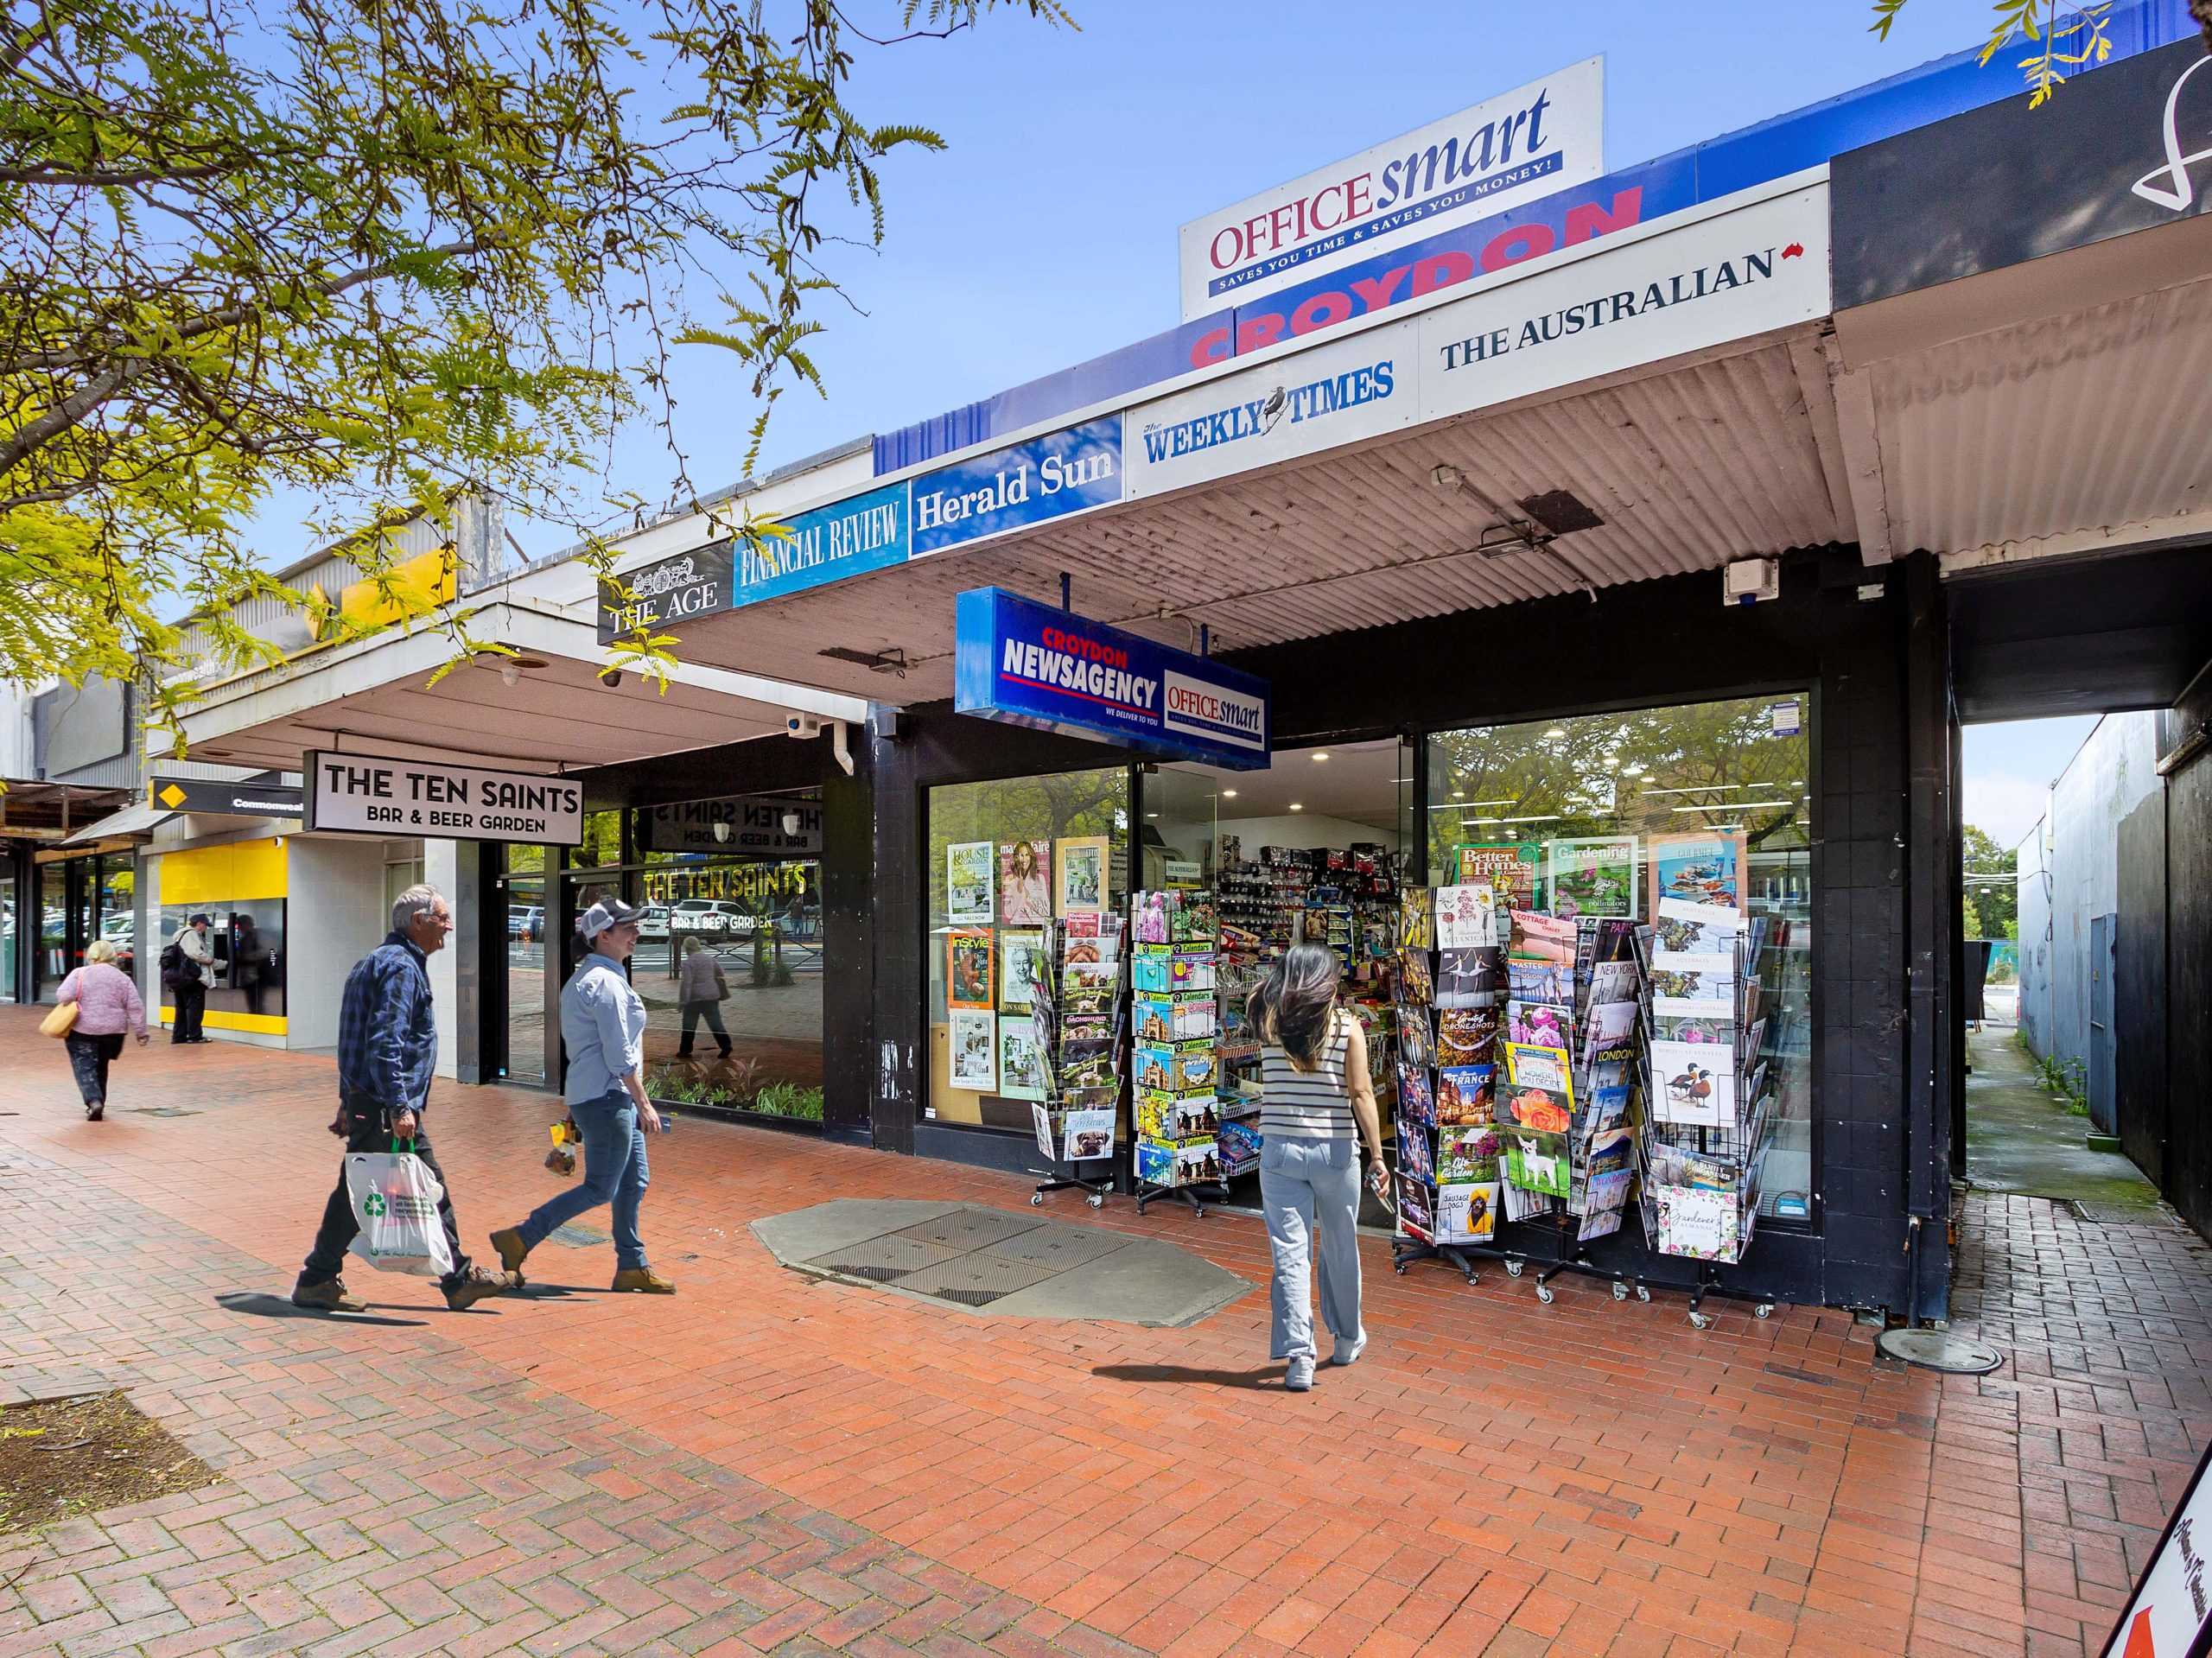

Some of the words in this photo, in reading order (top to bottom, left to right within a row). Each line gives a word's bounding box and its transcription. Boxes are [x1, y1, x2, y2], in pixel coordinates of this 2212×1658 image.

[1219, 268, 1263, 289] SAVES
[1268, 253, 1300, 270] YOU
[1306, 237, 1346, 257] TIME
[1353, 230, 1363, 239] &
[1371, 207, 1423, 233] SAVES
[1429, 192, 1466, 211] YOU
[1476, 160, 1553, 195] MONEY!
[1190, 186, 1643, 371] CROYDON
[1440, 327, 1510, 372] THE
[1516, 248, 1777, 353] AUSTRALIAN
[1143, 398, 1267, 464] WEEKLY
[1286, 359, 1393, 424] TIMES
[1143, 422, 1161, 433] The
[917, 466, 1029, 532] Herald
[1040, 451, 1115, 496] Sun
[829, 501, 899, 562] REVIEW
[610, 600, 658, 634] THE
[665, 582, 719, 619] AGE
[1042, 627, 1128, 670] CROYDON
[1003, 638, 1158, 708] NEWSAGENCY
[1106, 708, 1115, 716] WE
[1116, 710, 1137, 721] DELIVER
[1139, 715, 1147, 723] TO
[1147, 716, 1158, 726] YOU
[325, 765, 393, 797] THE
[407, 772, 469, 804] TEN
[481, 780, 579, 814] SAINTS
[367, 806, 403, 823] BAR
[410, 809, 423, 823] &
[429, 810, 474, 829] BEER
[480, 815, 546, 833] GARDEN
[1464, 849, 1514, 862] Better
[1558, 847, 1629, 859] Gardening
[1475, 861, 1532, 876] Homes
[643, 873, 680, 900] THE
[688, 868, 724, 899] TEN
[731, 864, 807, 896] SAINTS
[1588, 899, 1626, 908] pollinators
[671, 916, 690, 930] BAR
[730, 915, 772, 930] GARDEN
[1516, 913, 1549, 925] COTTAGE
[1611, 922, 1633, 934] PARIS
[953, 937, 989, 949] InStyle
[1512, 961, 1543, 969] MASTER
[1600, 964, 1618, 975] NEW
[1067, 1015, 1106, 1024] DACHSHUND
[1185, 1039, 1211, 1049] Calendars
[1599, 1049, 1634, 1062] LONDON
[1447, 1074, 1491, 1087] FRANCE
[1187, 1088, 1212, 1097] Calendars
[1187, 1136, 1212, 1147] Calendars
